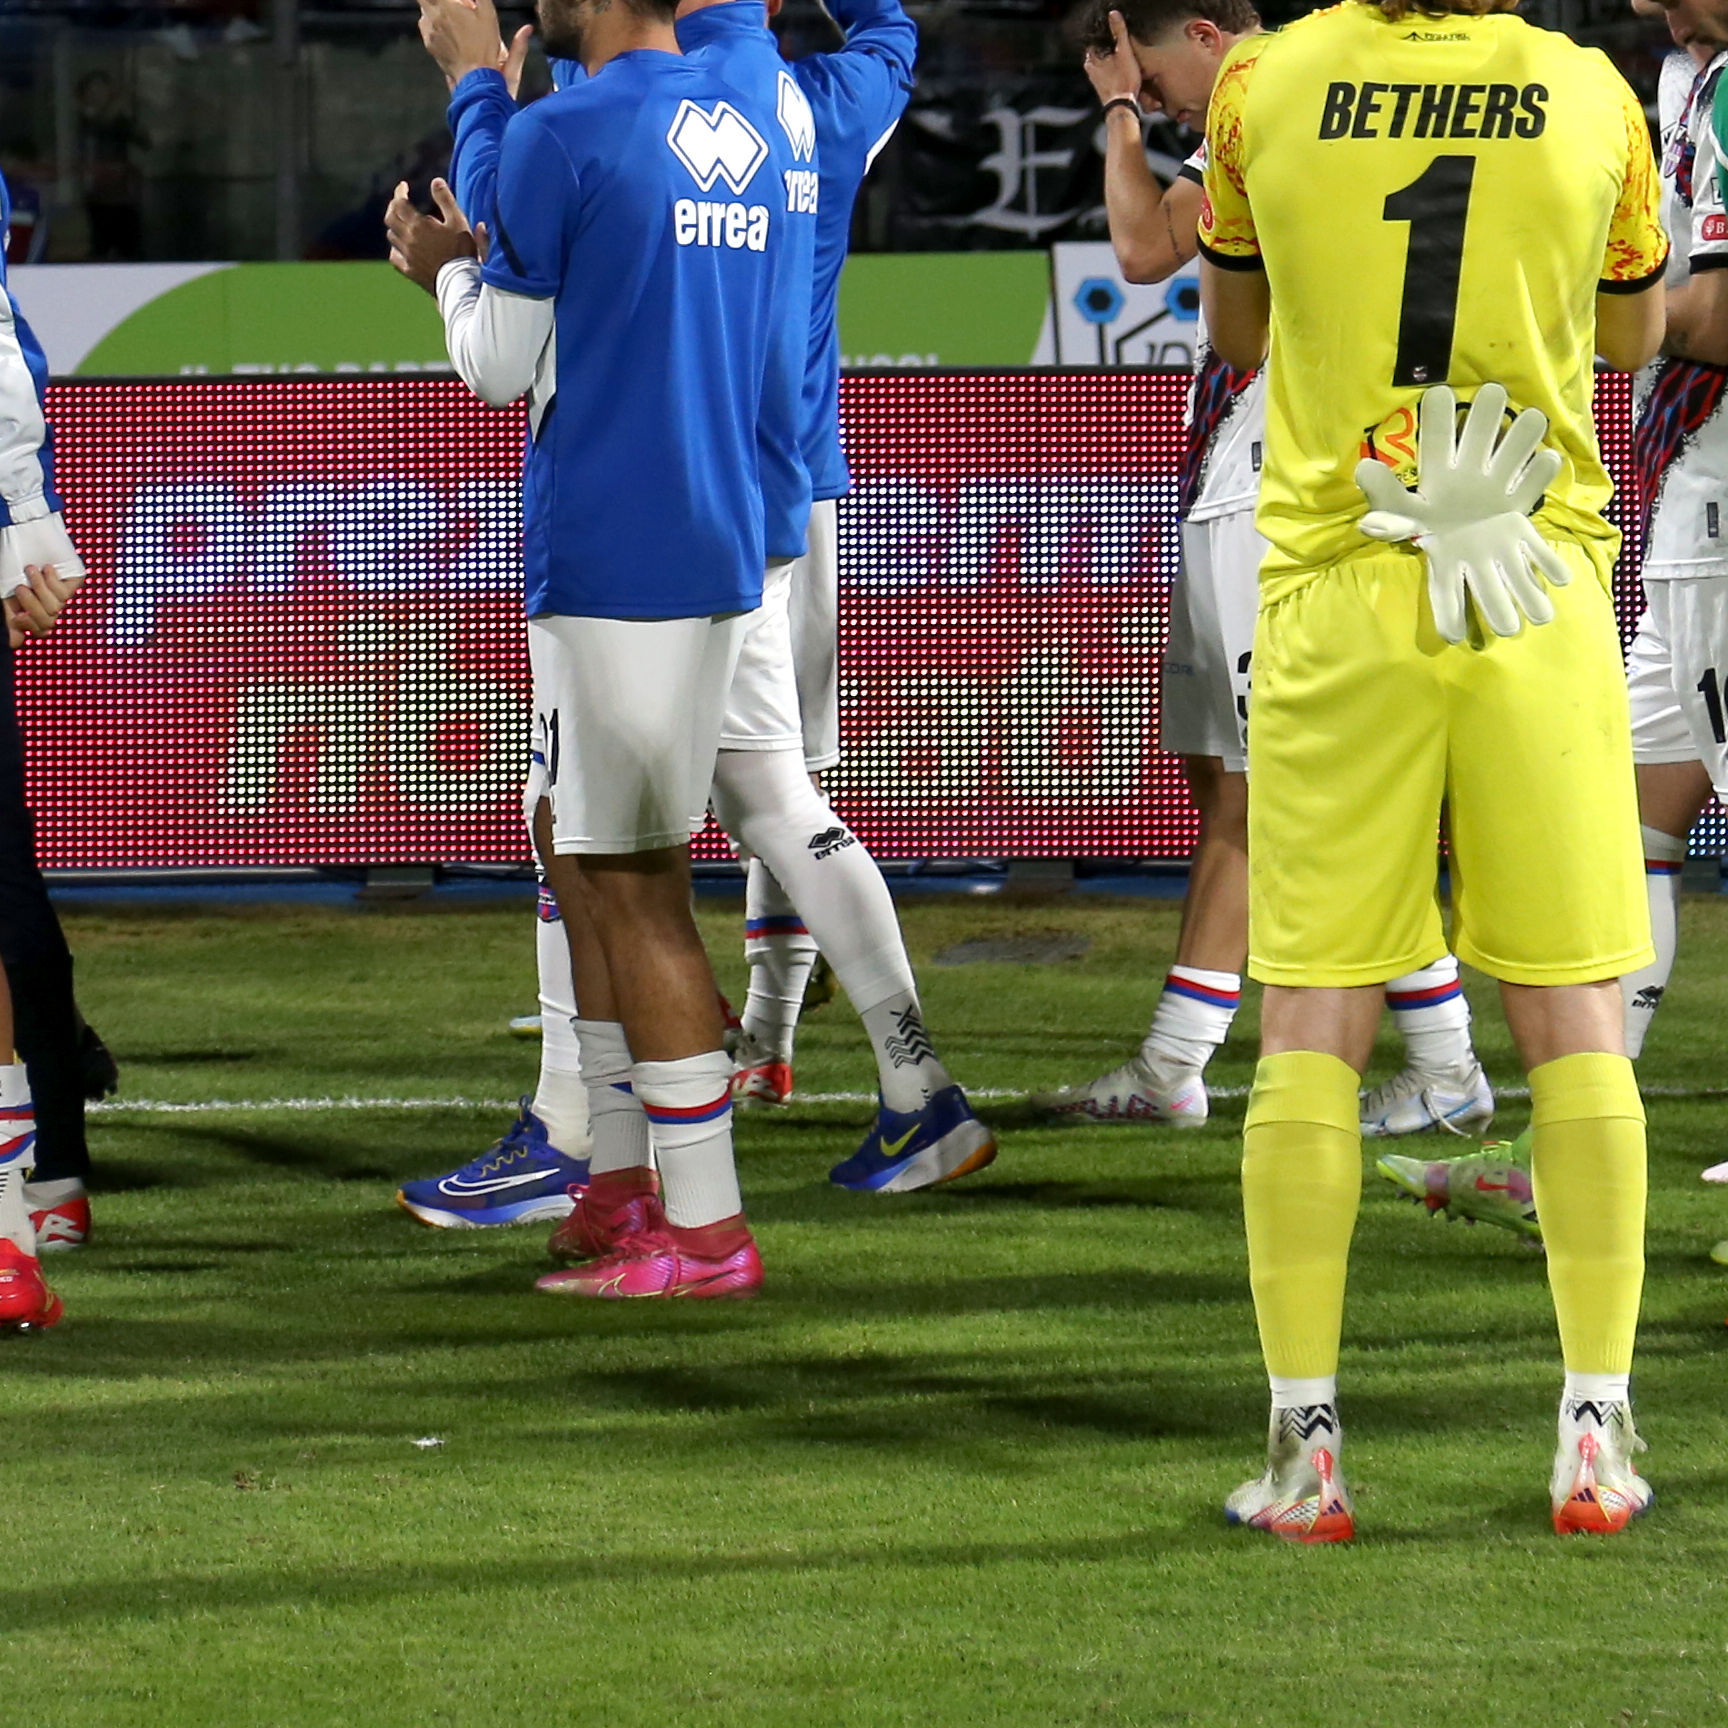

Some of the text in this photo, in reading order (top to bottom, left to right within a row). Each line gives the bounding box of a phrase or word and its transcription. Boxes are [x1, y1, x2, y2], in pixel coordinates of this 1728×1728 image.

[1319, 82, 1549, 140] BETHERS
[674, 198, 770, 252] errea
[1383, 155, 1476, 386] 1
[103, 469, 525, 649] prez
